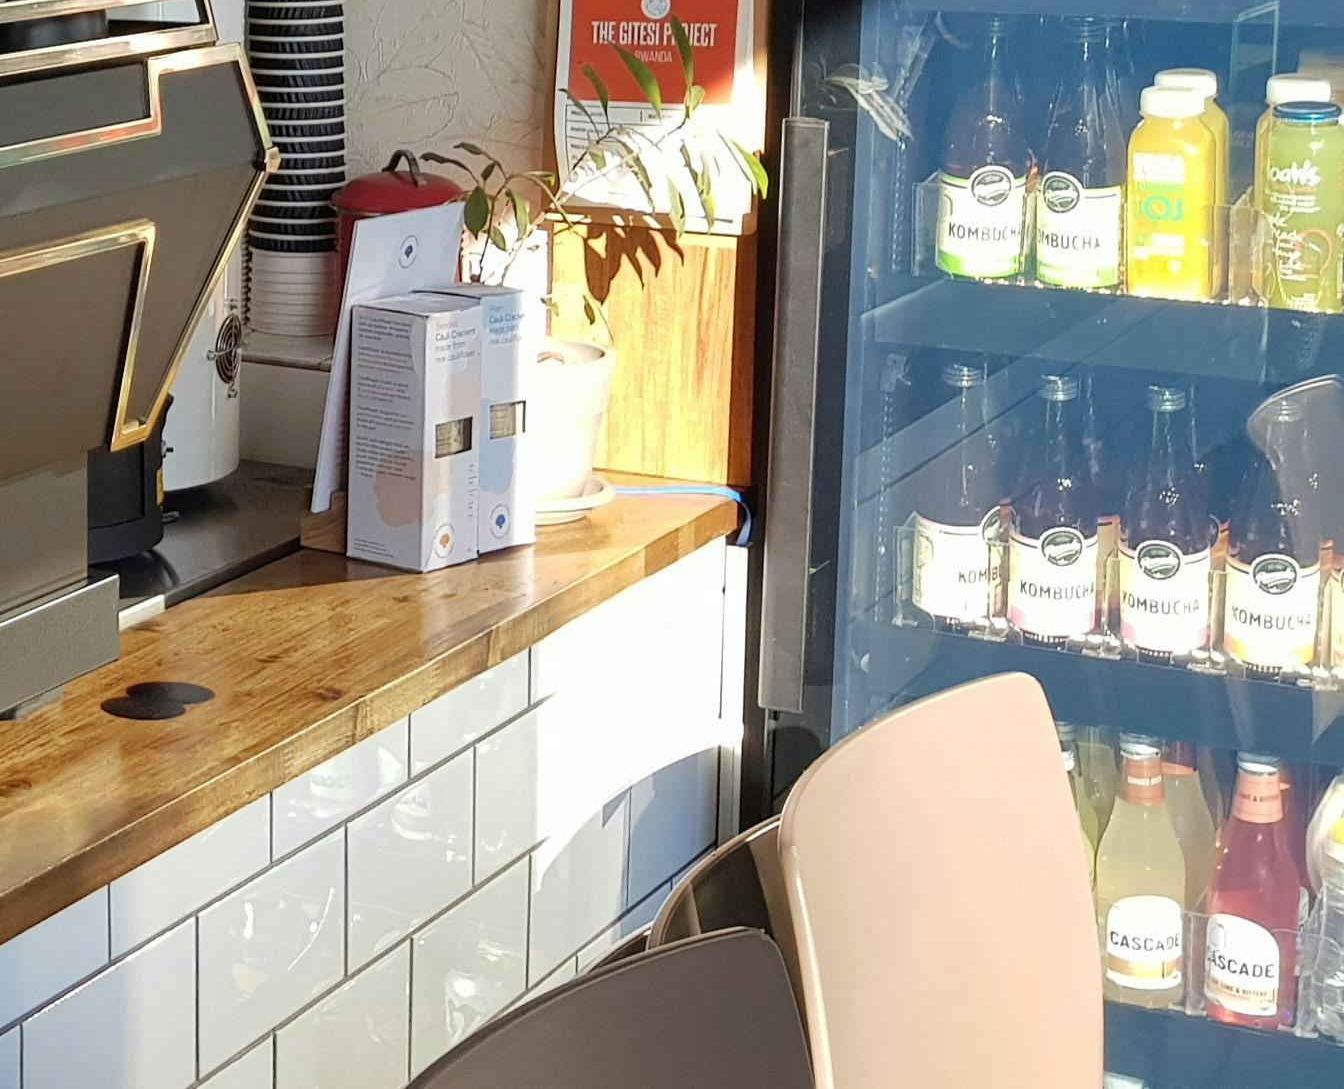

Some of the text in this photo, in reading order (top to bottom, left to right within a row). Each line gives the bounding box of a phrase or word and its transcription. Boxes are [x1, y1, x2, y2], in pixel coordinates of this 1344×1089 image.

[591, 20, 616, 45] THE
[618, 21, 661, 46] GITESI
[634, 49, 673, 63] RWANDA
[435, 327, 476, 342] Cauli Crackers
[452, 340, 466, 350] from
[1121, 590, 1201, 616] KOMBUCHA
[1109, 929, 1181, 953] CASCADE
